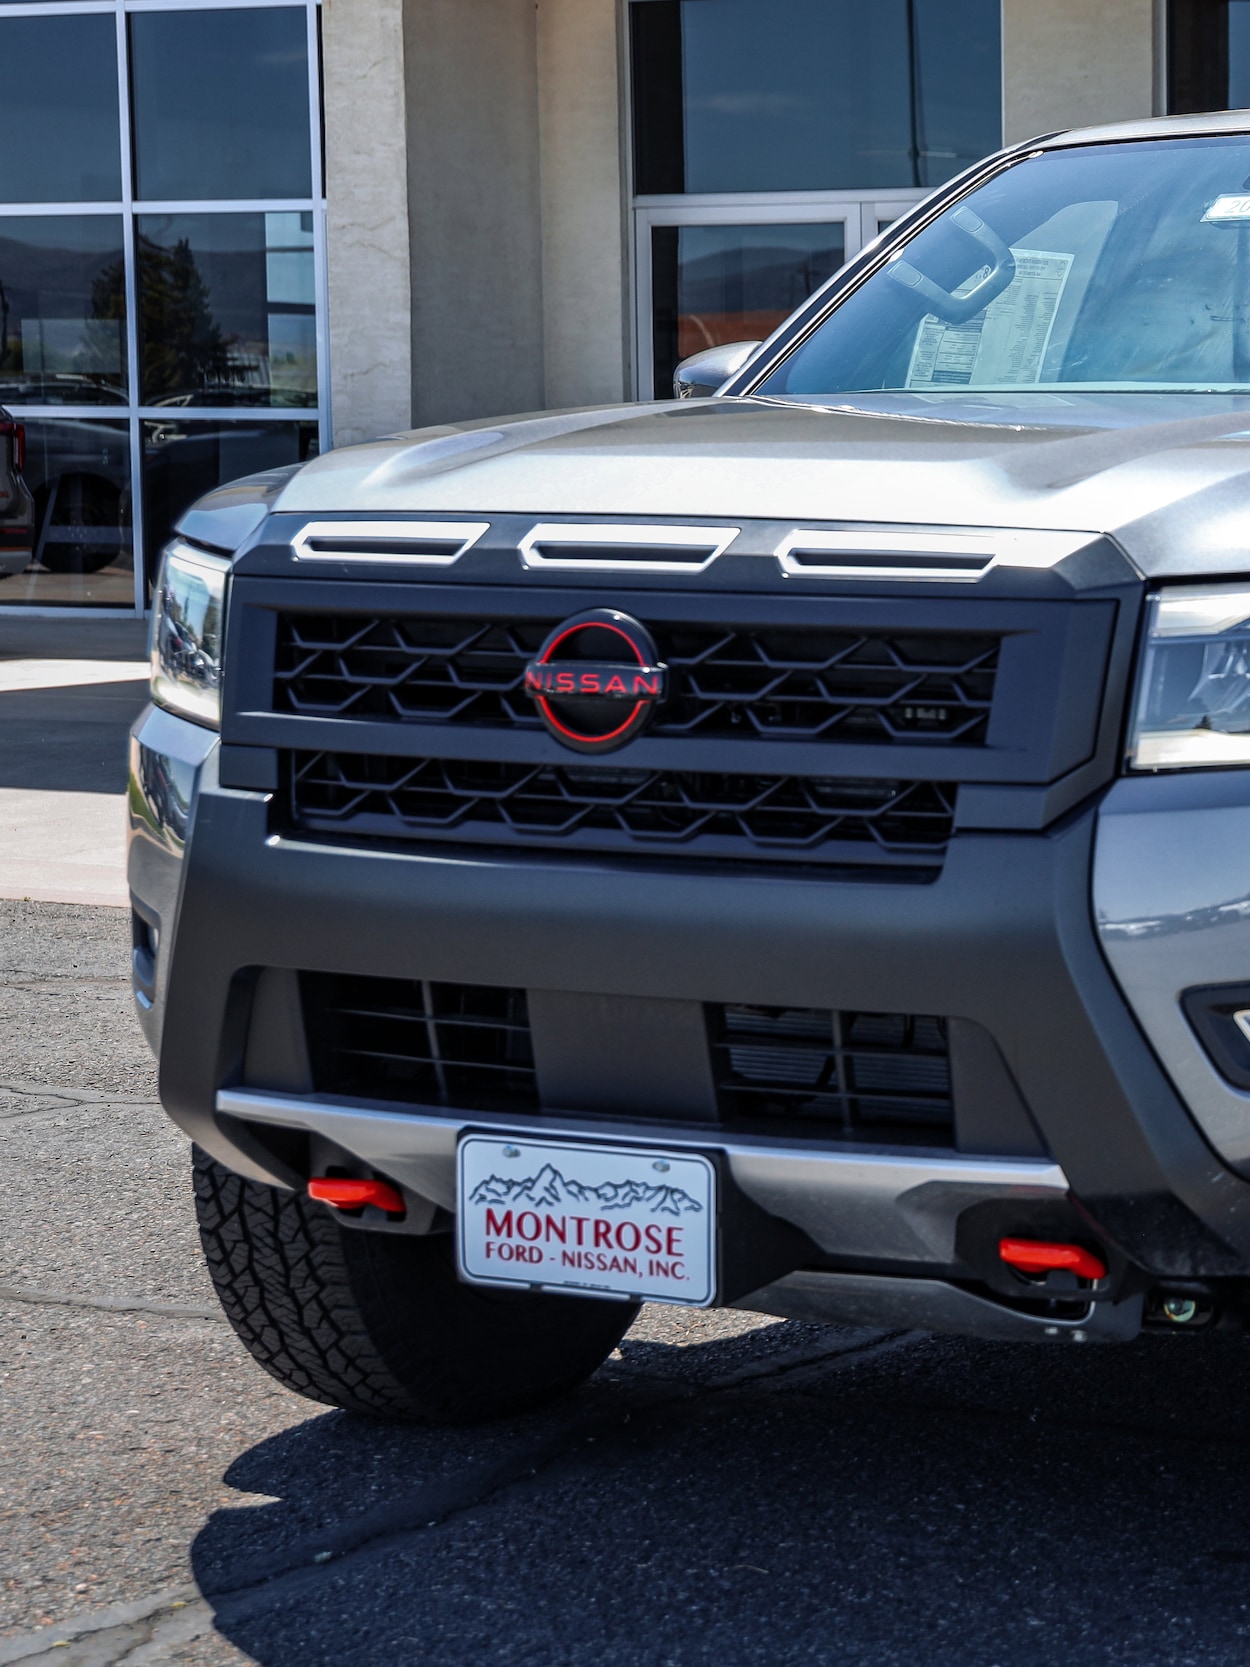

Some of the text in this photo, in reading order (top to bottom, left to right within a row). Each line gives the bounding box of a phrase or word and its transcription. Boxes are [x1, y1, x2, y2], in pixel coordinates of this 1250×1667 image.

[525, 671, 658, 694] NISSAN
[485, 1207, 684, 1257] MONTROSE
[485, 1241, 543, 1264] FORD
[561, 1250, 643, 1278] NISSAN,
[648, 1260, 690, 1281] INC.
